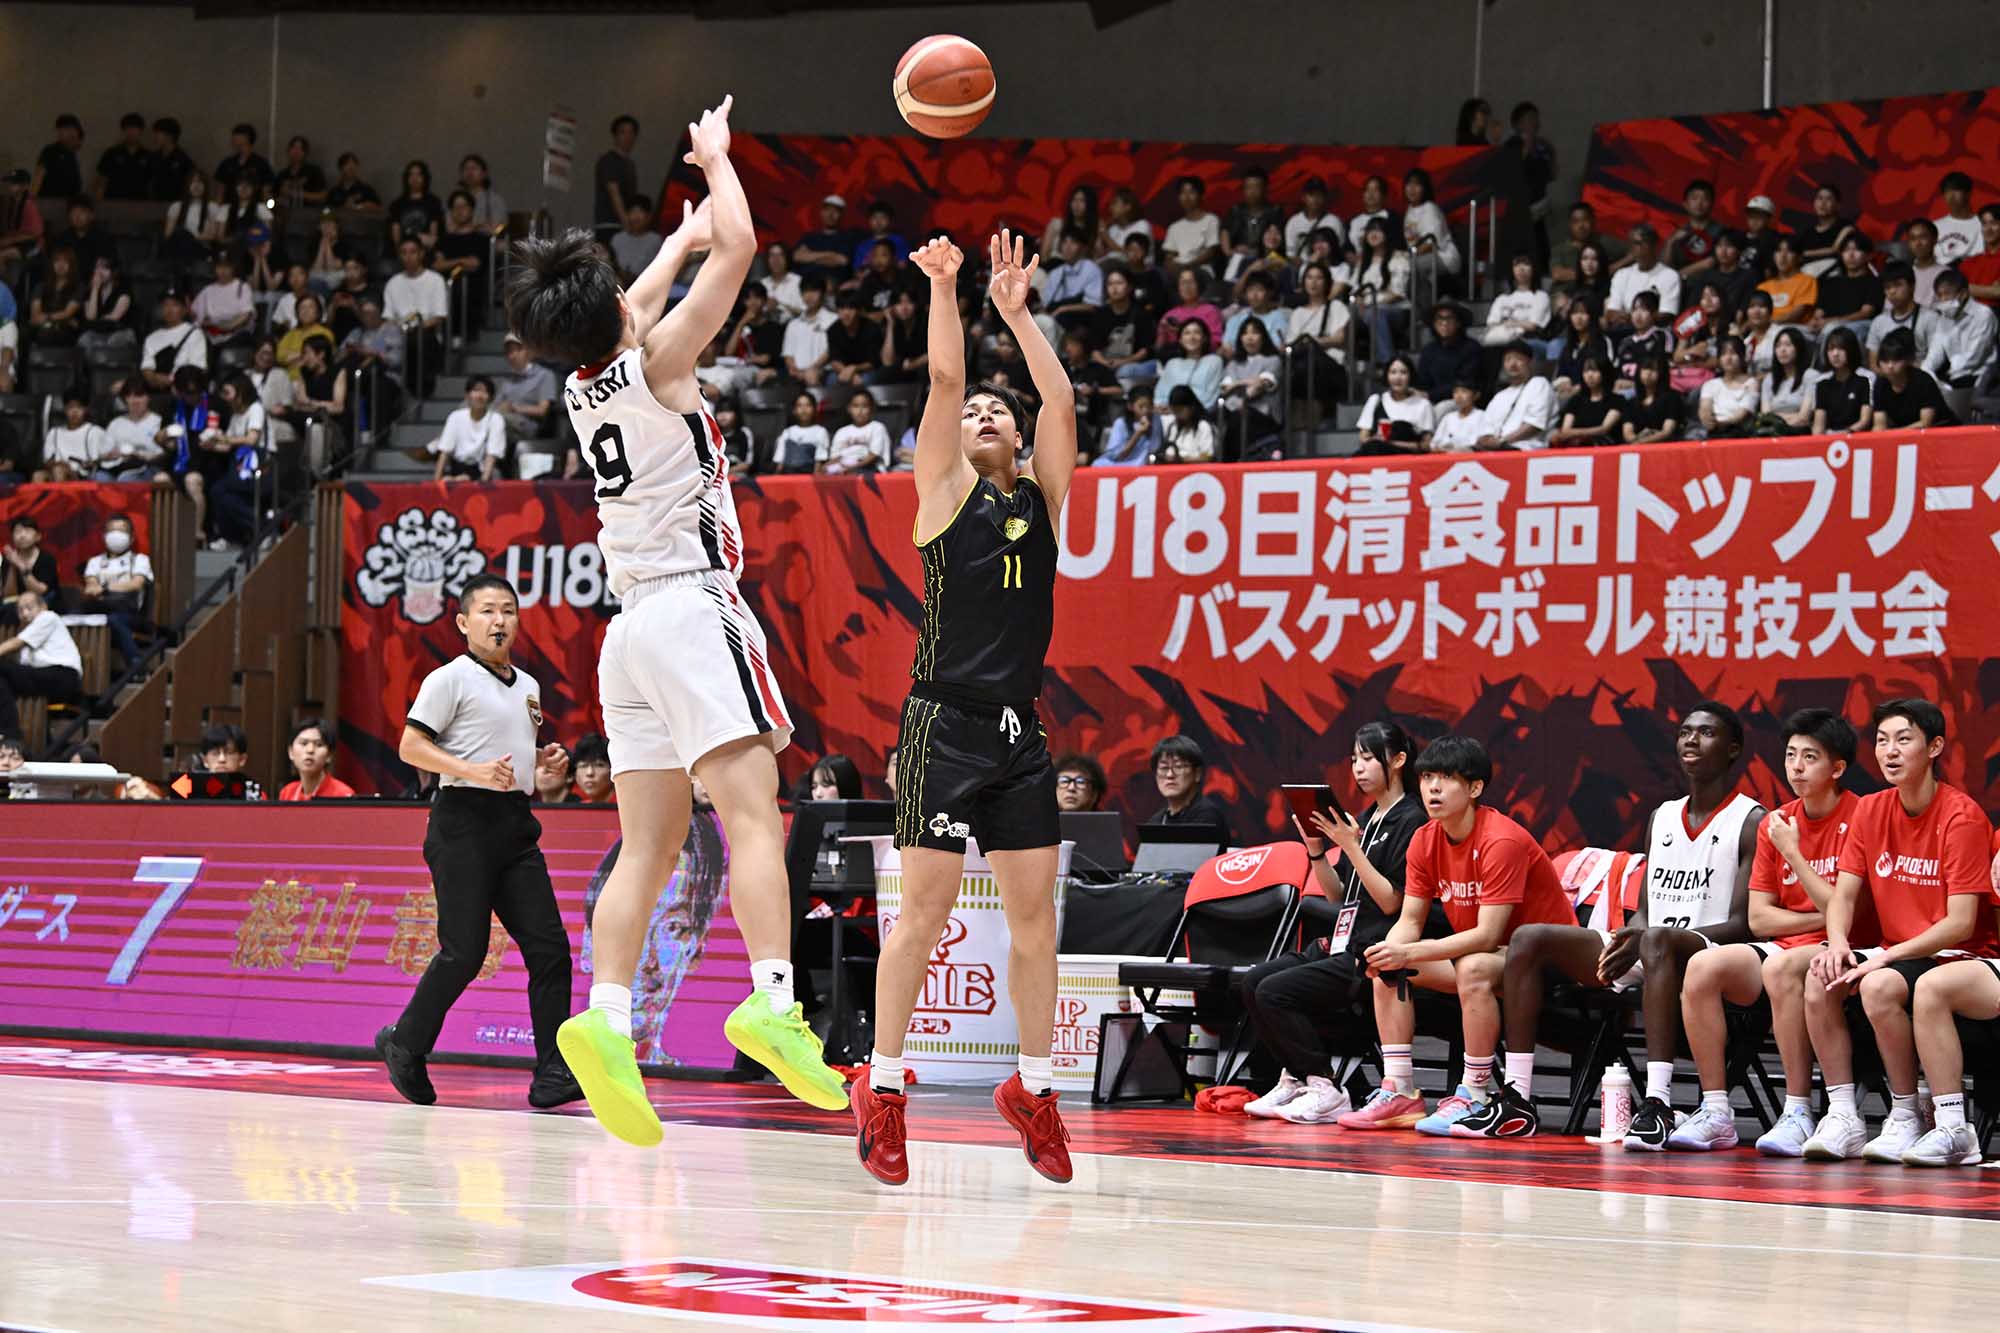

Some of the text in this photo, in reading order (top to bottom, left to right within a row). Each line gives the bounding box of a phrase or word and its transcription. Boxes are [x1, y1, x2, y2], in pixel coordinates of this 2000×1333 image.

[589, 423, 633, 497] 9
[506, 542, 622, 608] U18
[1003, 554, 1022, 588] 11
[1161, 568, 1950, 663] バスケットボール競技大会
[1221, 852, 1262, 873] NISSIN
[105, 856, 206, 985] 7
[605, 1271, 1092, 1322] NISSIN
